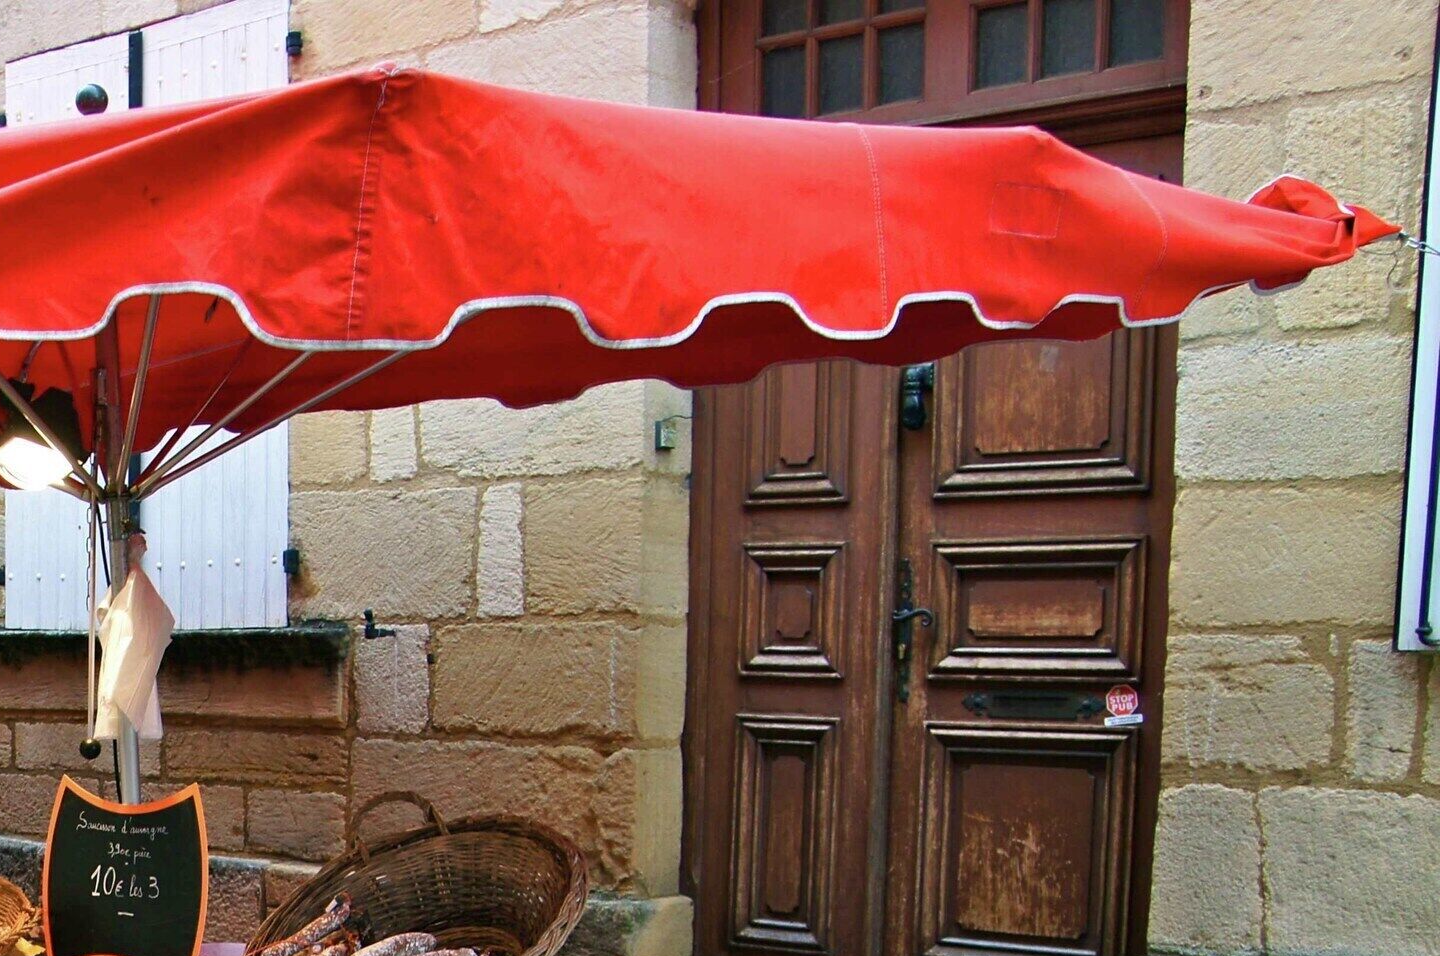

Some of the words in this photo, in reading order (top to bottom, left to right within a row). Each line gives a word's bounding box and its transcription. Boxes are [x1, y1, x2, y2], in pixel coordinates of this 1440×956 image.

[1109, 694, 1134, 704] STOP
[1112, 702, 1133, 711] PUB
[90, 864, 124, 897] 10€
[129, 874, 143, 898] les
[148, 876, 160, 899] 3
